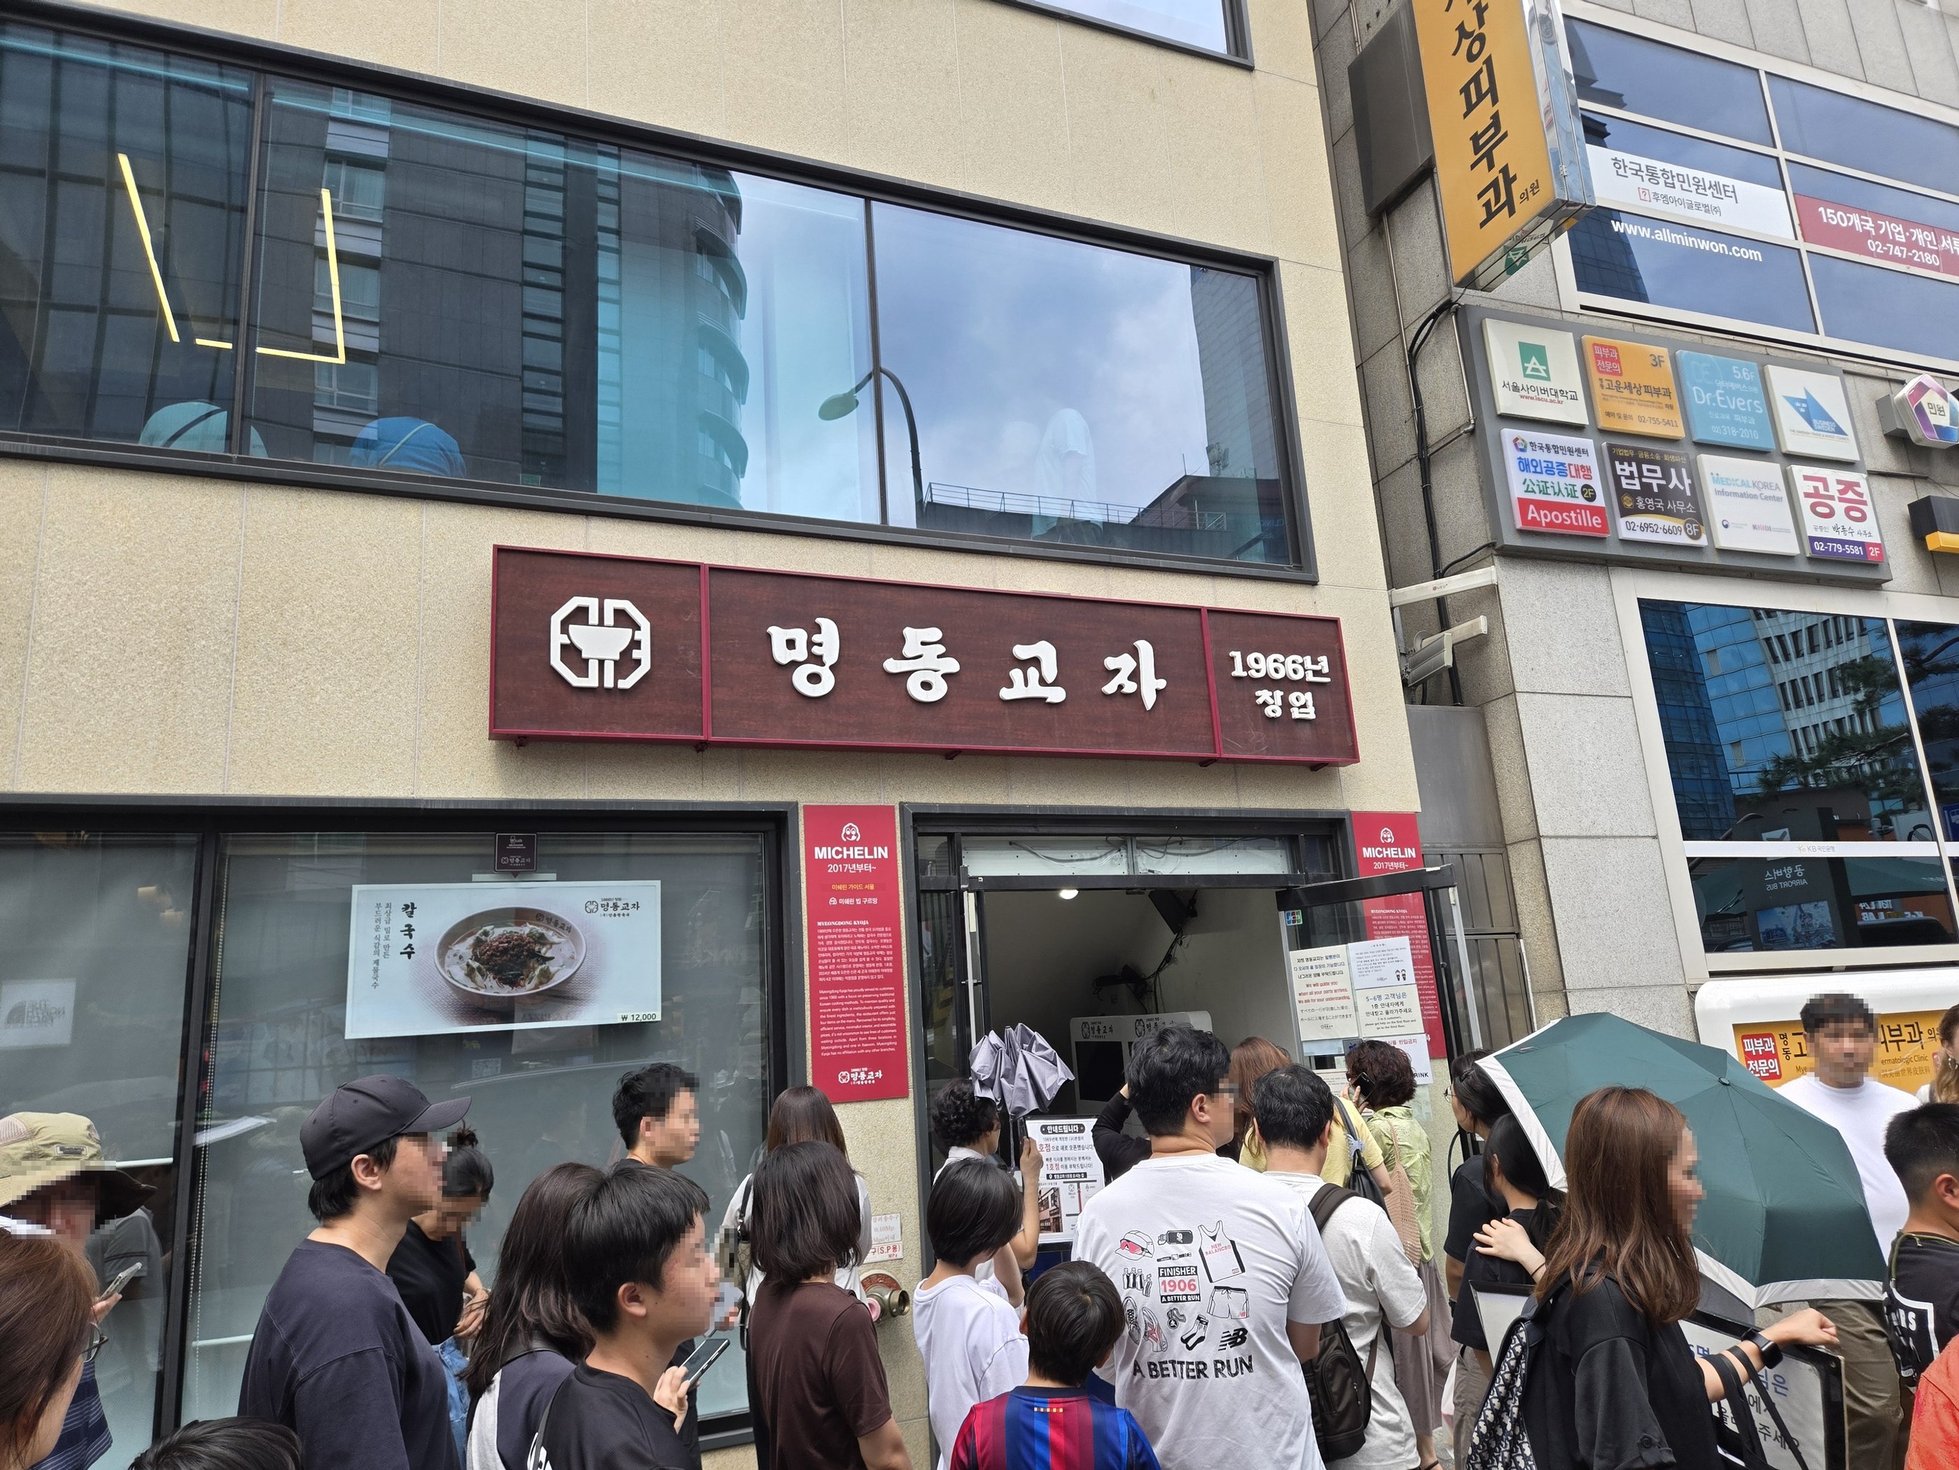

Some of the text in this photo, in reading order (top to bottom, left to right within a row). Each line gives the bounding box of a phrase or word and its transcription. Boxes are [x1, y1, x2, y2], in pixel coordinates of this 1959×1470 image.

[1611, 157, 1738, 204] 한국통합민원센터
[1519, 179, 1540, 204] 의원
[1818, 207, 1875, 236] 150개국
[1611, 220, 1762, 263] www.allminwon.com
[1868, 239, 1940, 267] 02-747-2180
[1594, 345, 1618, 360] 피부과
[1649, 353, 1665, 369] 3F
[1597, 360, 1622, 374] 전문의
[1502, 380, 1579, 401] 서울사이버대학교
[1693, 386, 1763, 414] Dr.Evers
[1927, 401, 1946, 417] 민원
[1637, 415, 1679, 428] 02-755-5411
[1529, 441, 1589, 458] 한국통합민원센터
[1517, 456, 1593, 481] 해외공증대행
[1615, 460, 1692, 497] 법무사
[1522, 478, 1579, 498] 公证认证
[1582, 487, 1595, 499] 2F
[1714, 488, 1784, 504] Information Center
[1635, 496, 1697, 514] 홍영국 사무소
[1802, 474, 1868, 523] 공증
[1527, 504, 1602, 529] Apostille
[1685, 523, 1700, 537] 8F
[1814, 541, 1865, 556] 02-779-5581
[1869, 545, 1881, 557] 2F
[767, 616, 1167, 712] 명동교자
[1229, 650, 1332, 685] 1966년
[1254, 688, 1318, 721] 창업
[814, 846, 889, 860] MICHELIN
[1362, 847, 1416, 858] MICHELIN
[600, 901, 640, 912] 명동교자
[400, 902, 417, 960] 칼국수
[1384, 991, 1407, 1000] 고객님은
[631, 1013, 657, 1022] 12,000
[1743, 1036, 1775, 1056] 피부과
[1778, 1032, 1792, 1061] 명동
[1747, 1058, 1780, 1078] 전문의
[1880, 1056, 1914, 1066] ermatologic
[1913, 1053, 1929, 1063] Clinic
[851, 1070, 883, 1081] 명동교자
[1047, 1125, 1079, 1133] 안내드립니다
[1159, 1267, 1197, 1277] FINISHER
[1160, 1278, 1197, 1293] 1906
[1187, 1294, 1200, 1302] RUN
[1132, 1354, 1255, 1380] A BETTER RUN
